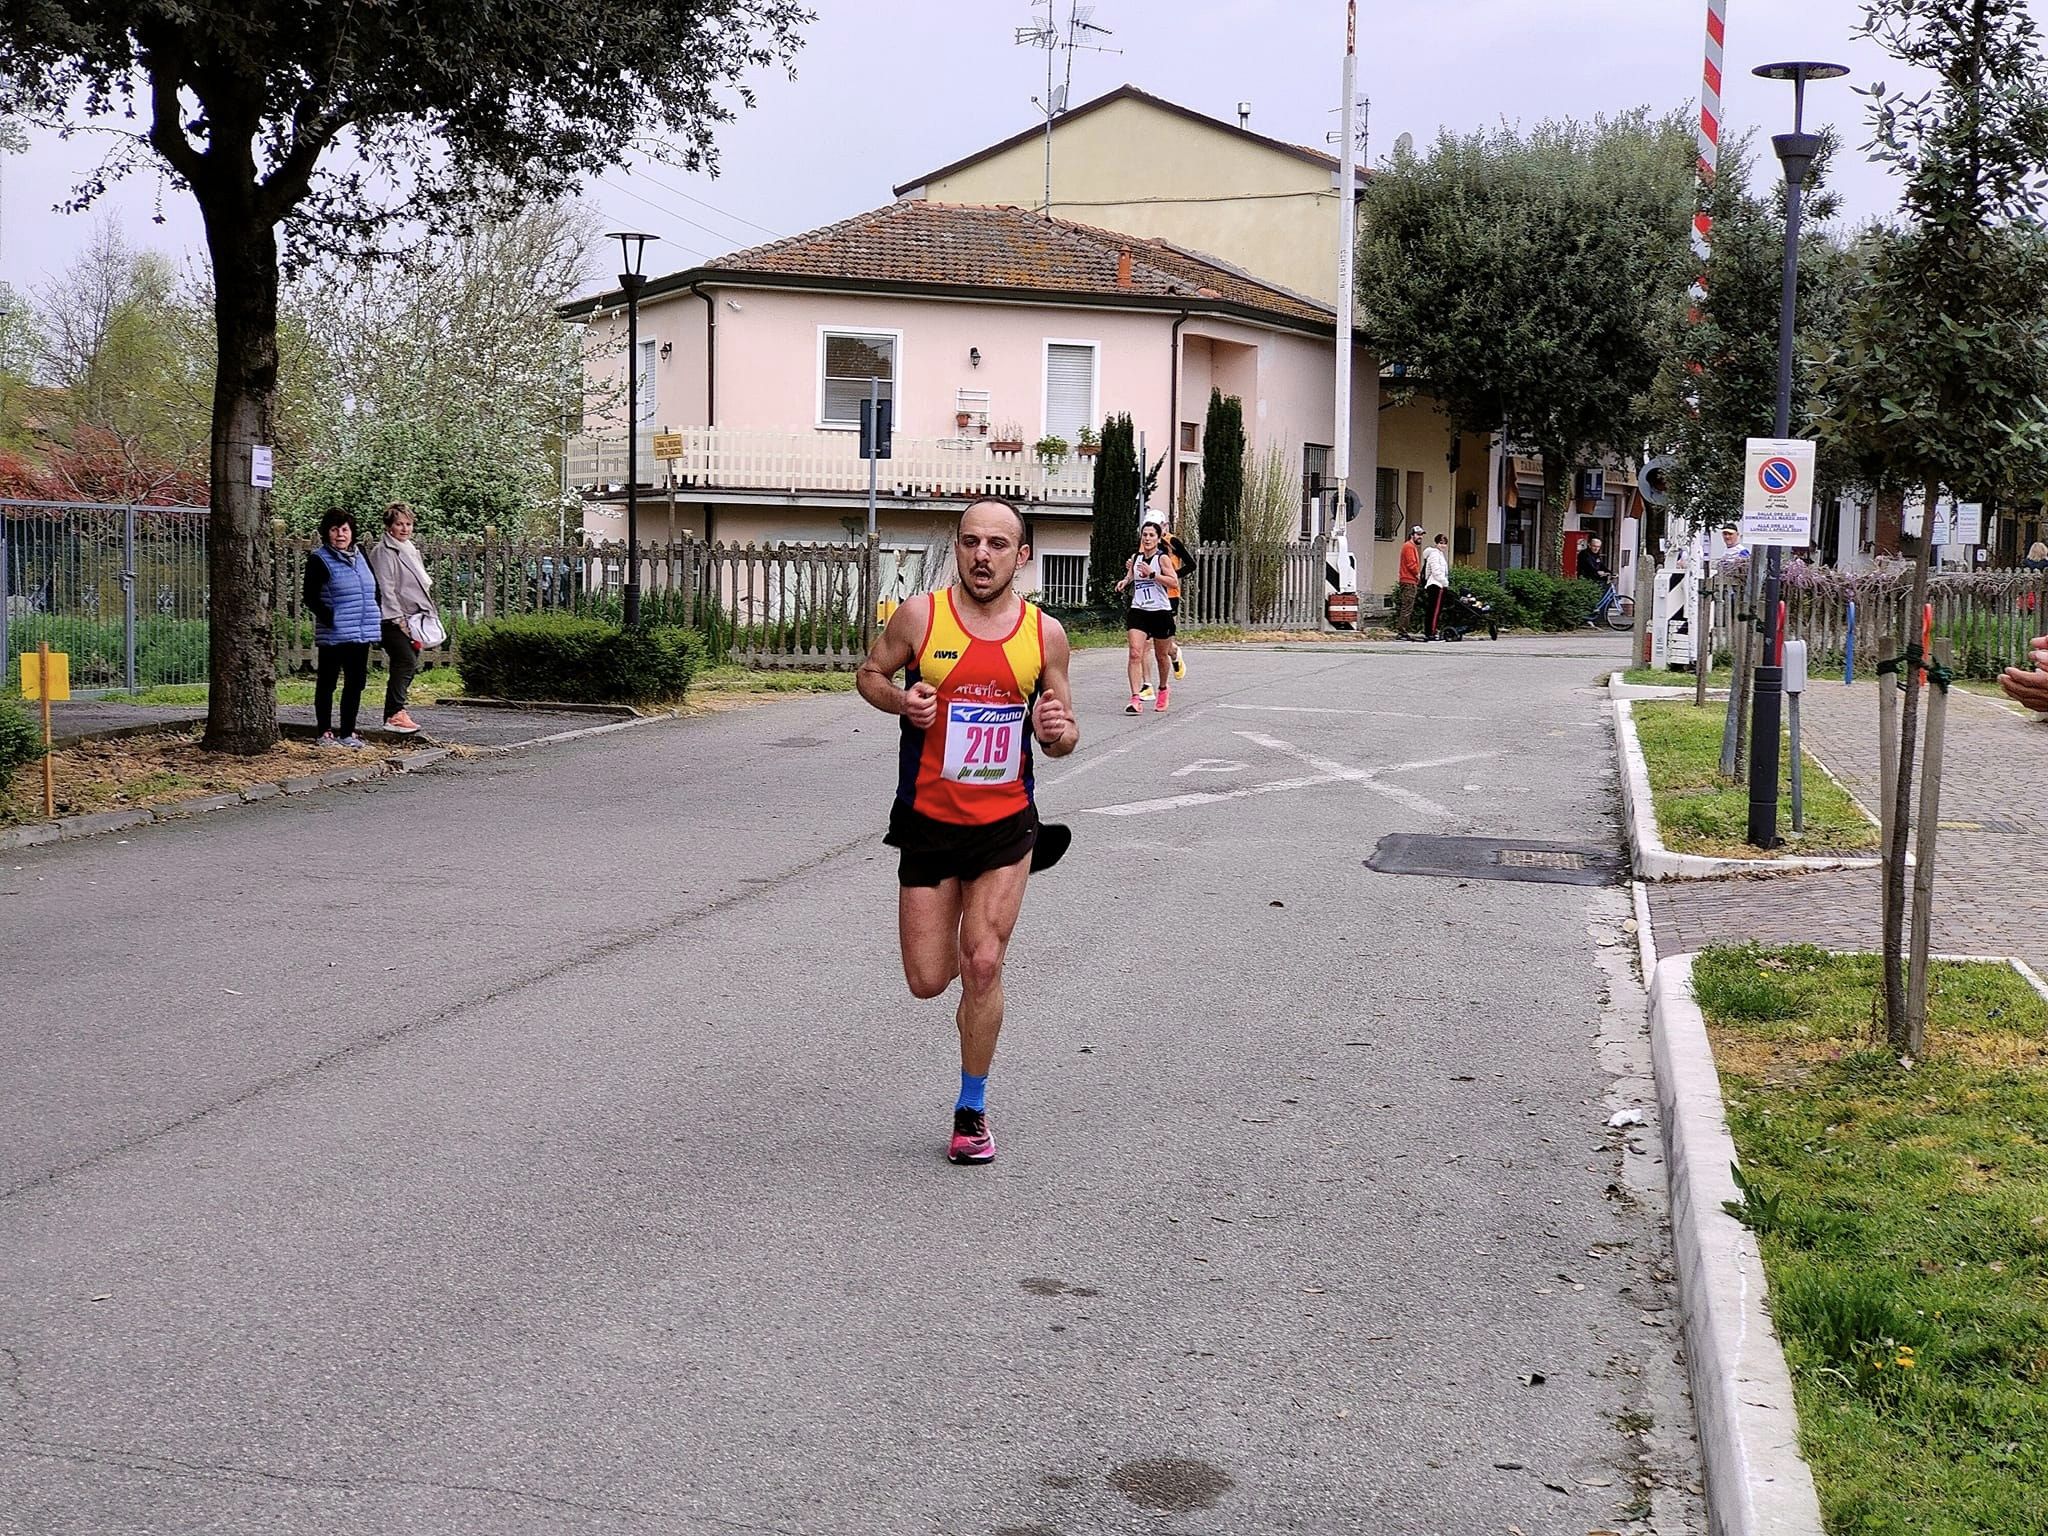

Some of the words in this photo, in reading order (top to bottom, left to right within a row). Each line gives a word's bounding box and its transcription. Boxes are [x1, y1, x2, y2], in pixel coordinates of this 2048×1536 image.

[1142, 588, 1151, 600] 11
[933, 650, 958, 659] AVIS
[978, 710, 1022, 722] MIZUNO
[963, 726, 1011, 764] 219
